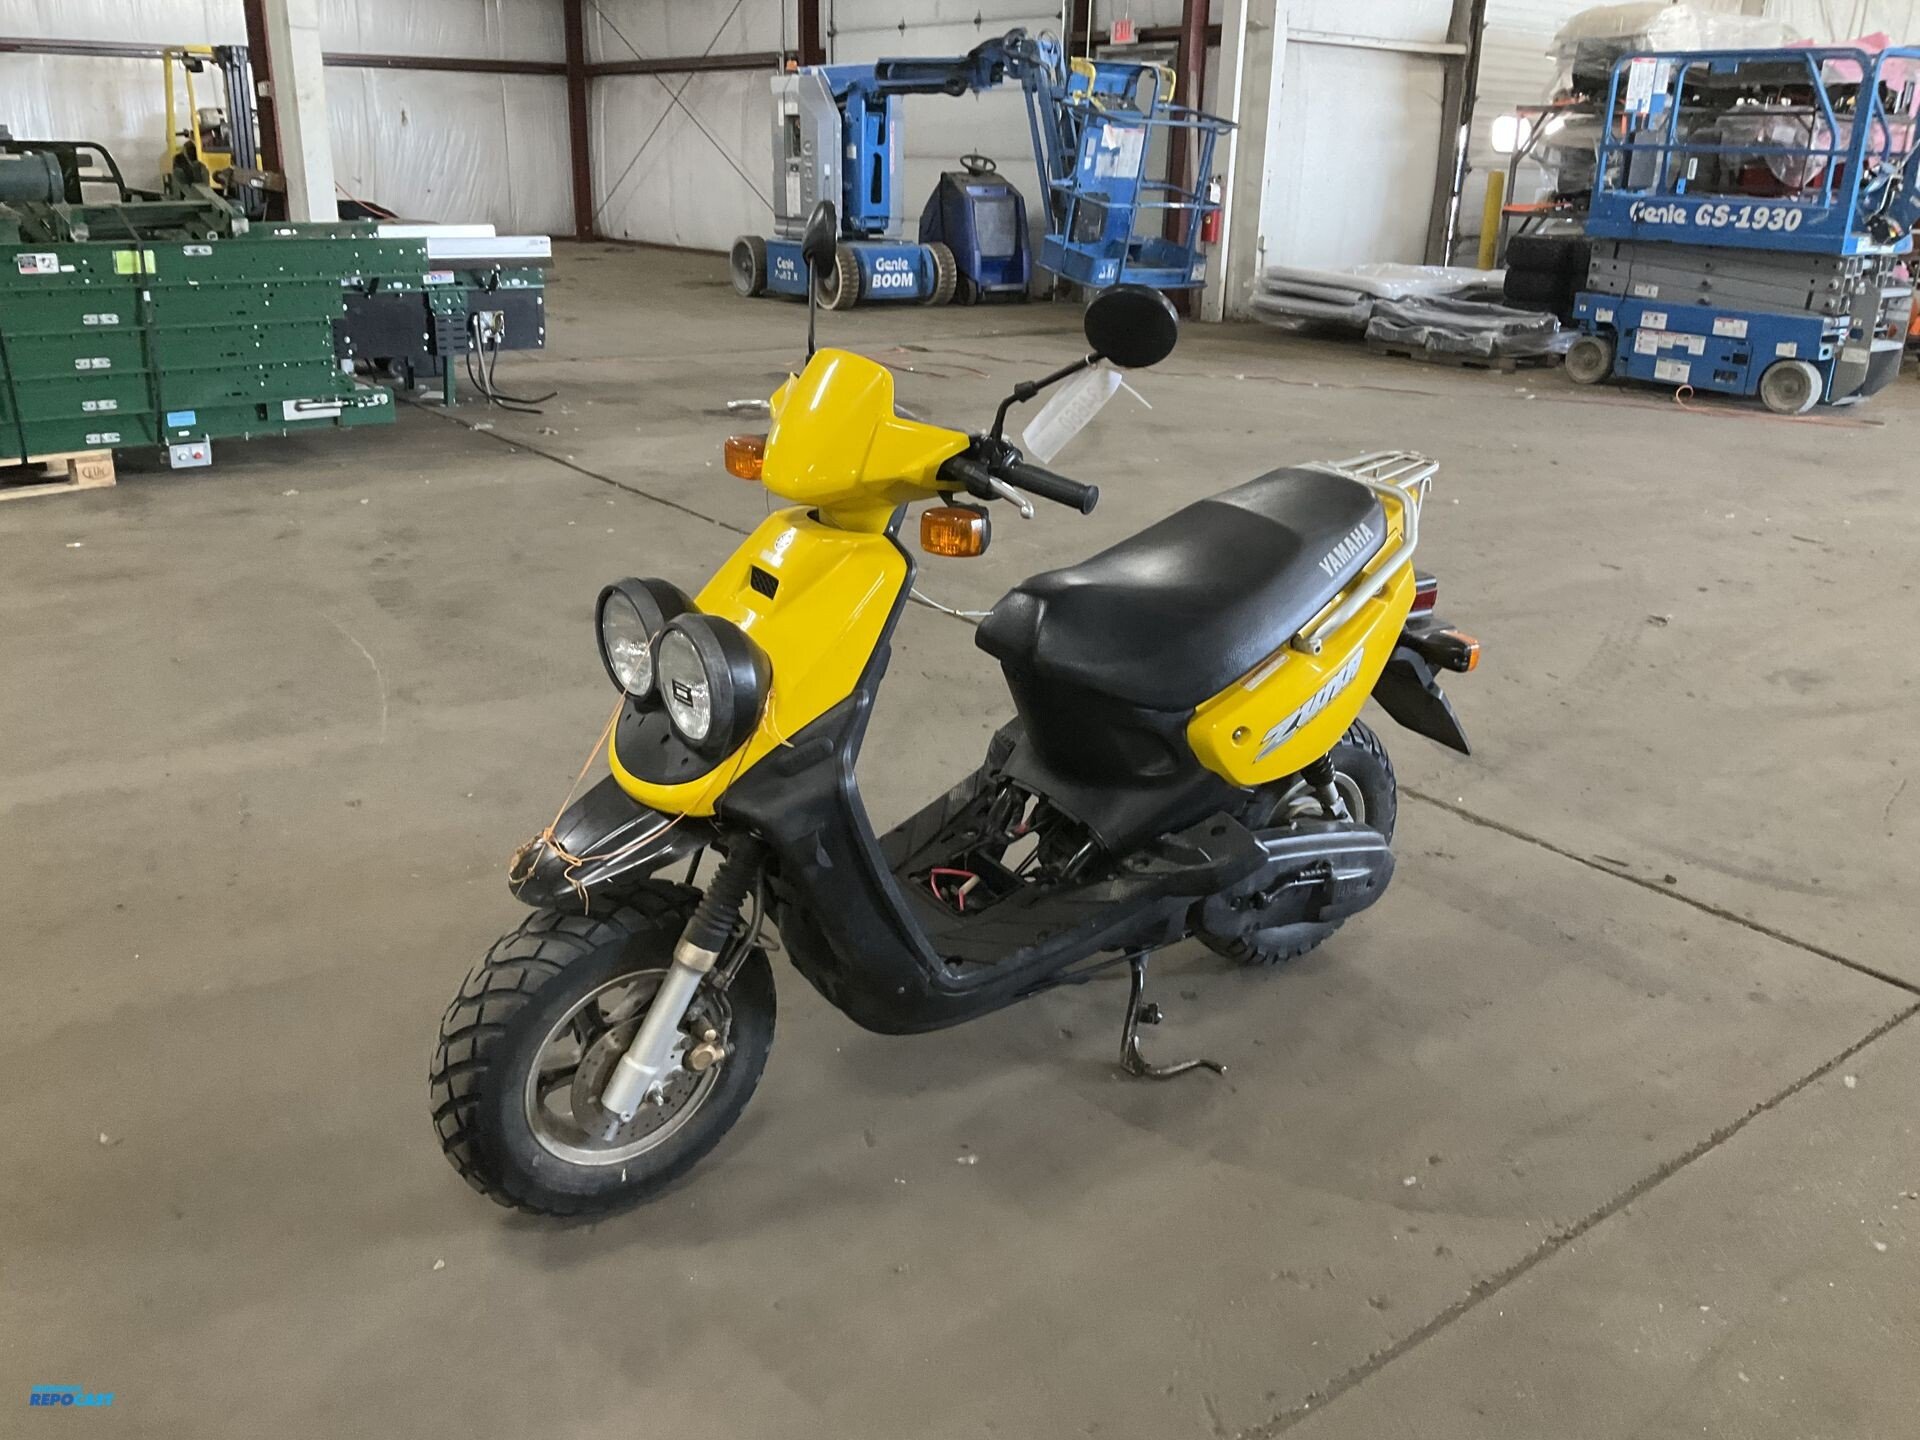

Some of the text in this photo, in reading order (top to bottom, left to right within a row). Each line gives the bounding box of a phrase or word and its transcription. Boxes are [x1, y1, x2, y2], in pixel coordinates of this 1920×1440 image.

[1629, 200, 1803, 232] Genie GS-1930
[875, 257, 909, 271] Genie
[872, 271, 914, 289] BOOM
[1318, 522, 1374, 577] YAMAHA
